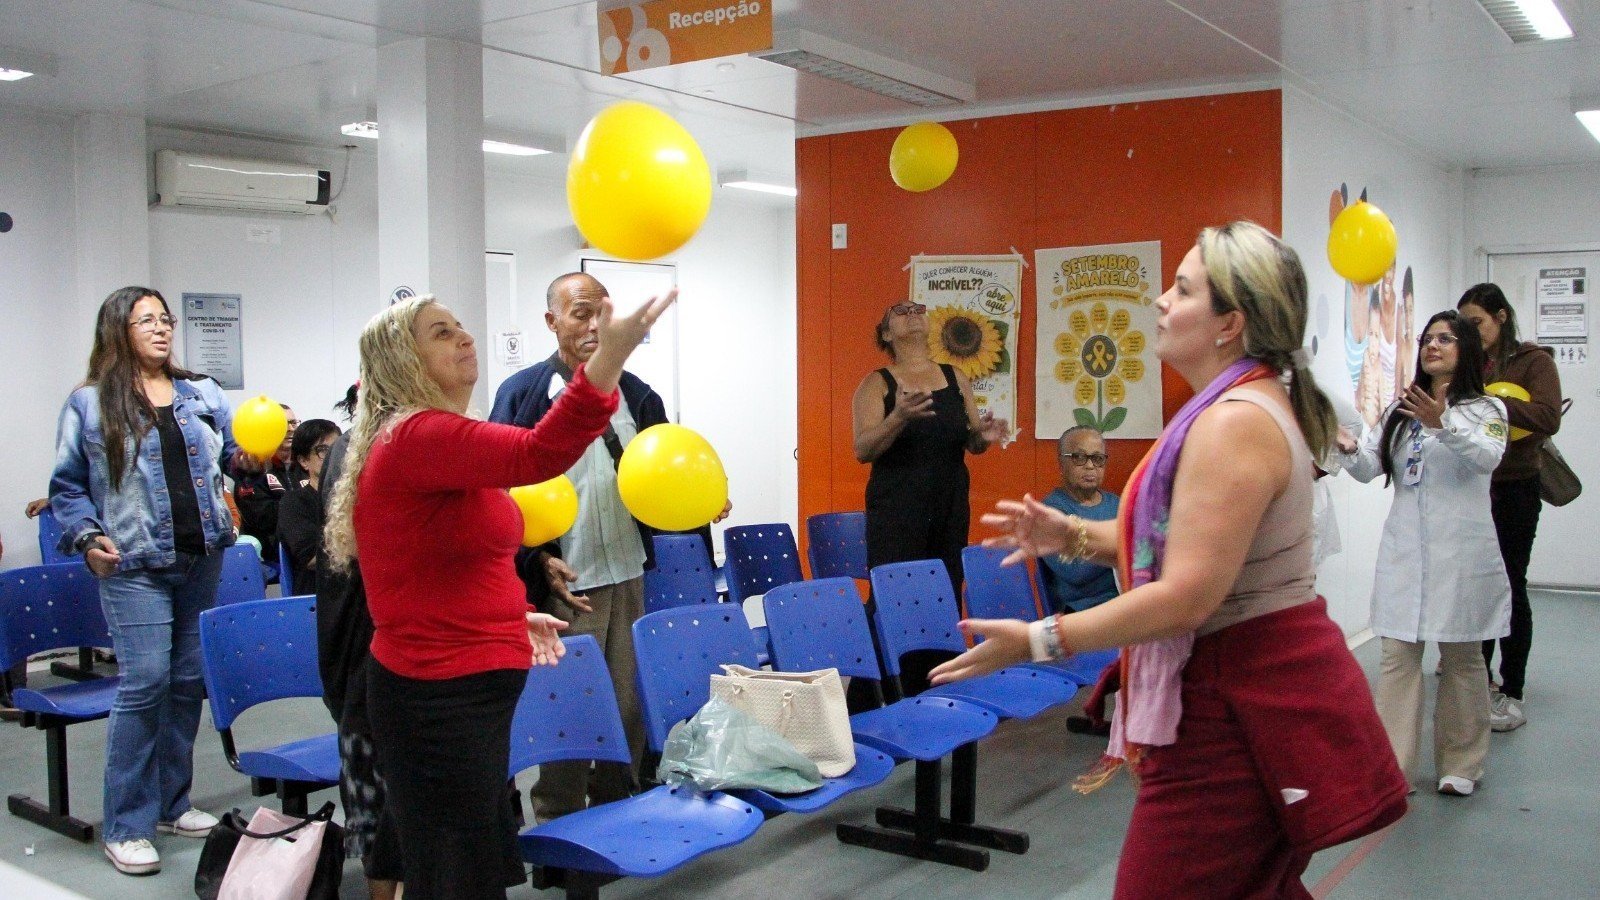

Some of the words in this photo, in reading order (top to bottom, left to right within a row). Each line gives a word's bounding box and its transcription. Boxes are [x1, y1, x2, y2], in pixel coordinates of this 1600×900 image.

[669, 0, 761, 29] Recepção
[922, 268, 938, 280] QUER
[938, 265, 968, 275] CONHECER
[968, 266, 994, 278] ALGUÉM
[1061, 254, 1140, 276] SETEMBRO
[928, 276, 984, 291] INCRÍVEL??
[1066, 270, 1140, 292] AMARELO
[986, 287, 1006, 302] abre
[985, 300, 1008, 312] aqui
